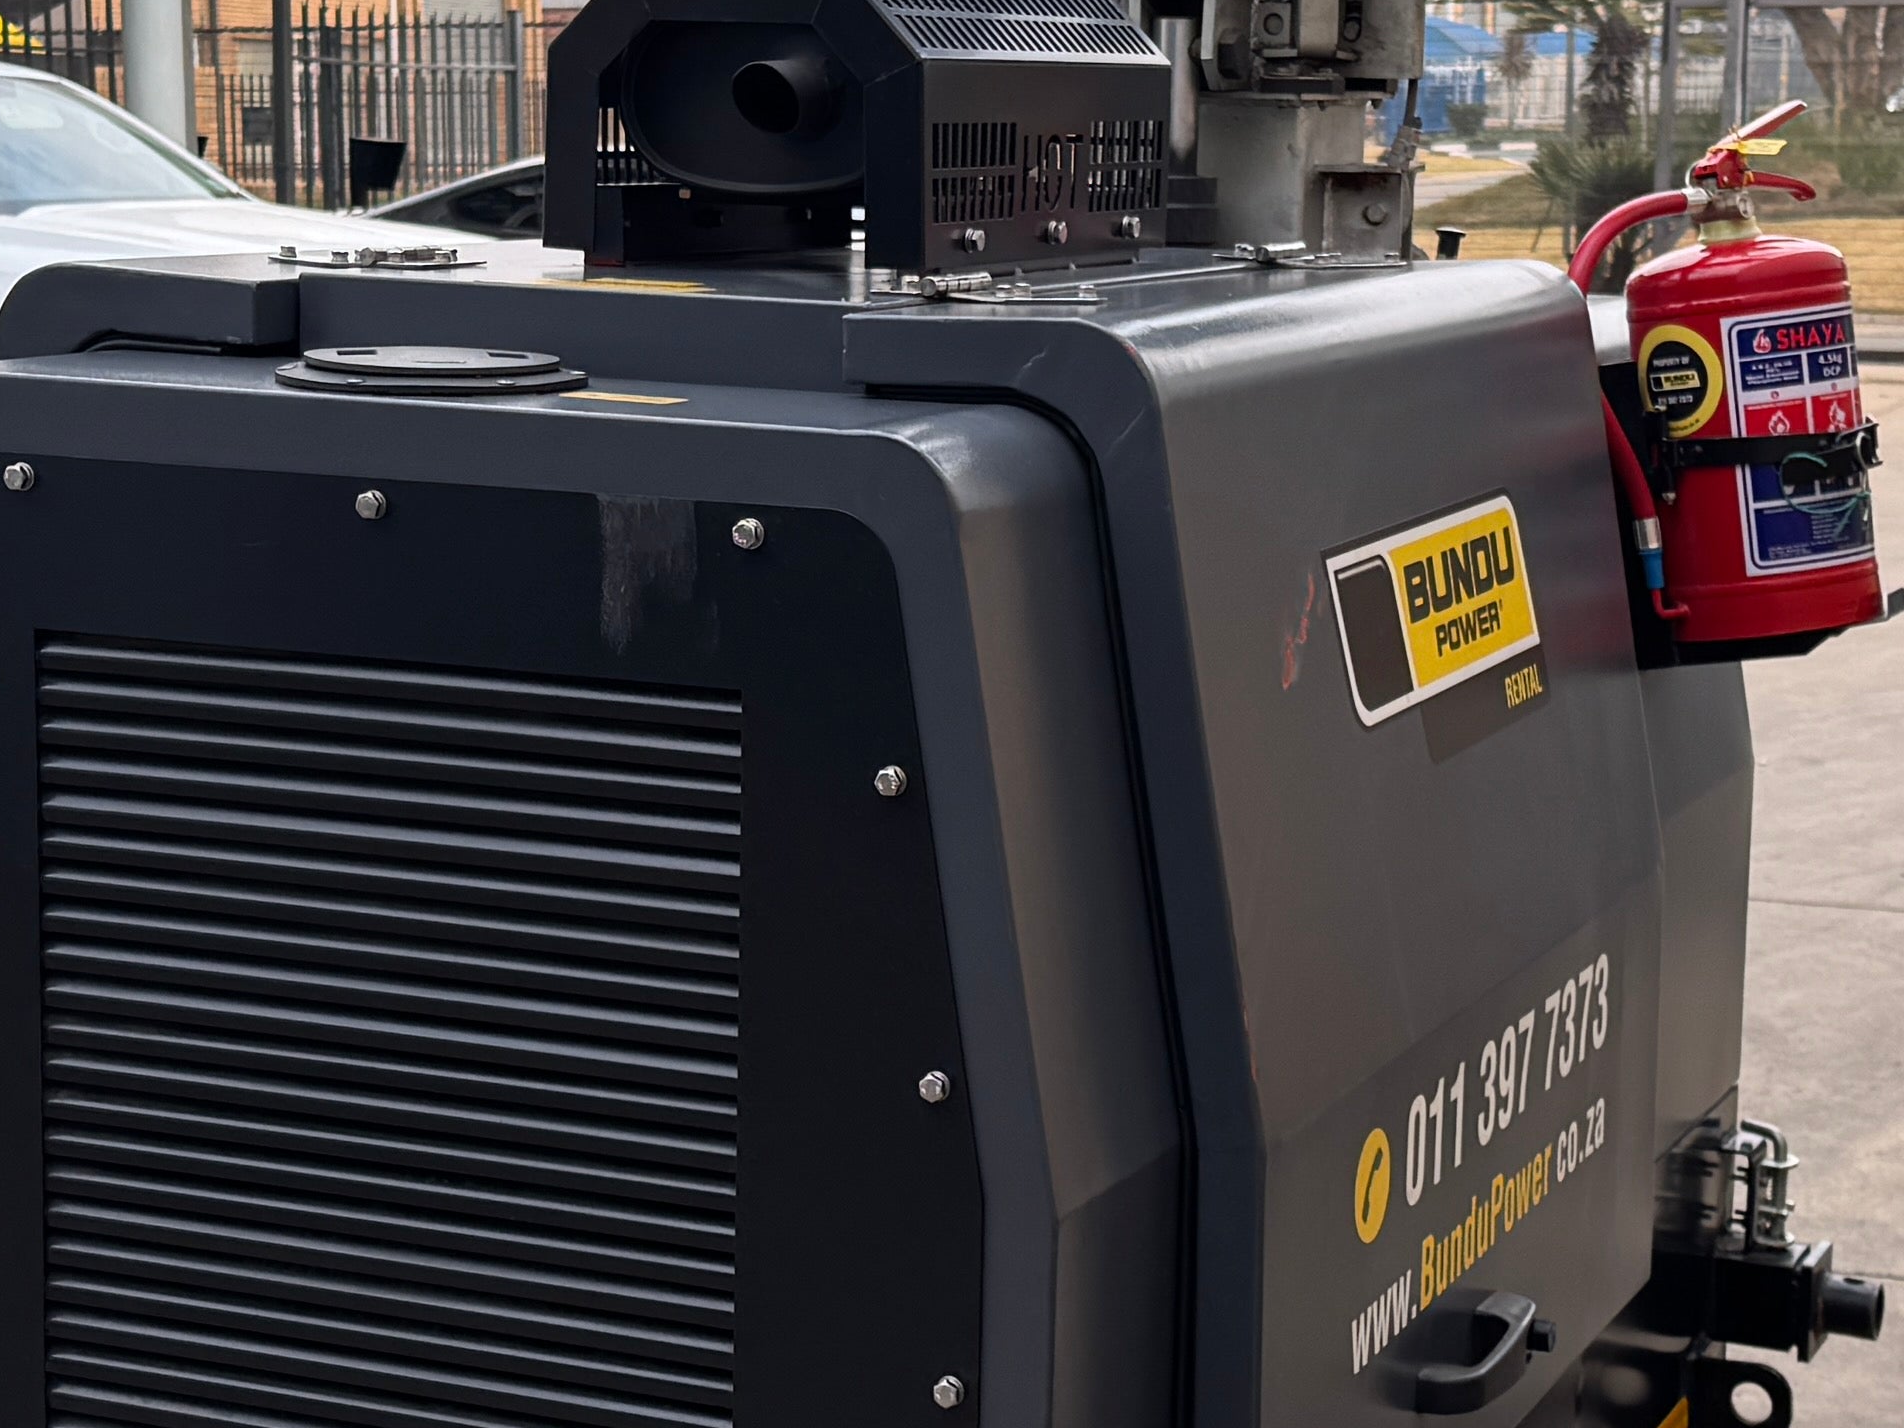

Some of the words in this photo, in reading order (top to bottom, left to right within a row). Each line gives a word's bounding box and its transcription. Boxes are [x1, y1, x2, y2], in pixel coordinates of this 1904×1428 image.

[1021, 134, 1084, 212] HOT
[1776, 323, 1846, 351] SHAYA
[1403, 526, 1515, 625] BUNDU
[1435, 600, 1502, 658] POWER
[1504, 663, 1543, 709] RENTAL
[1405, 1061, 1466, 1207] 011
[1477, 1008, 1535, 1147] 397
[1544, 953, 1609, 1091] 7373
